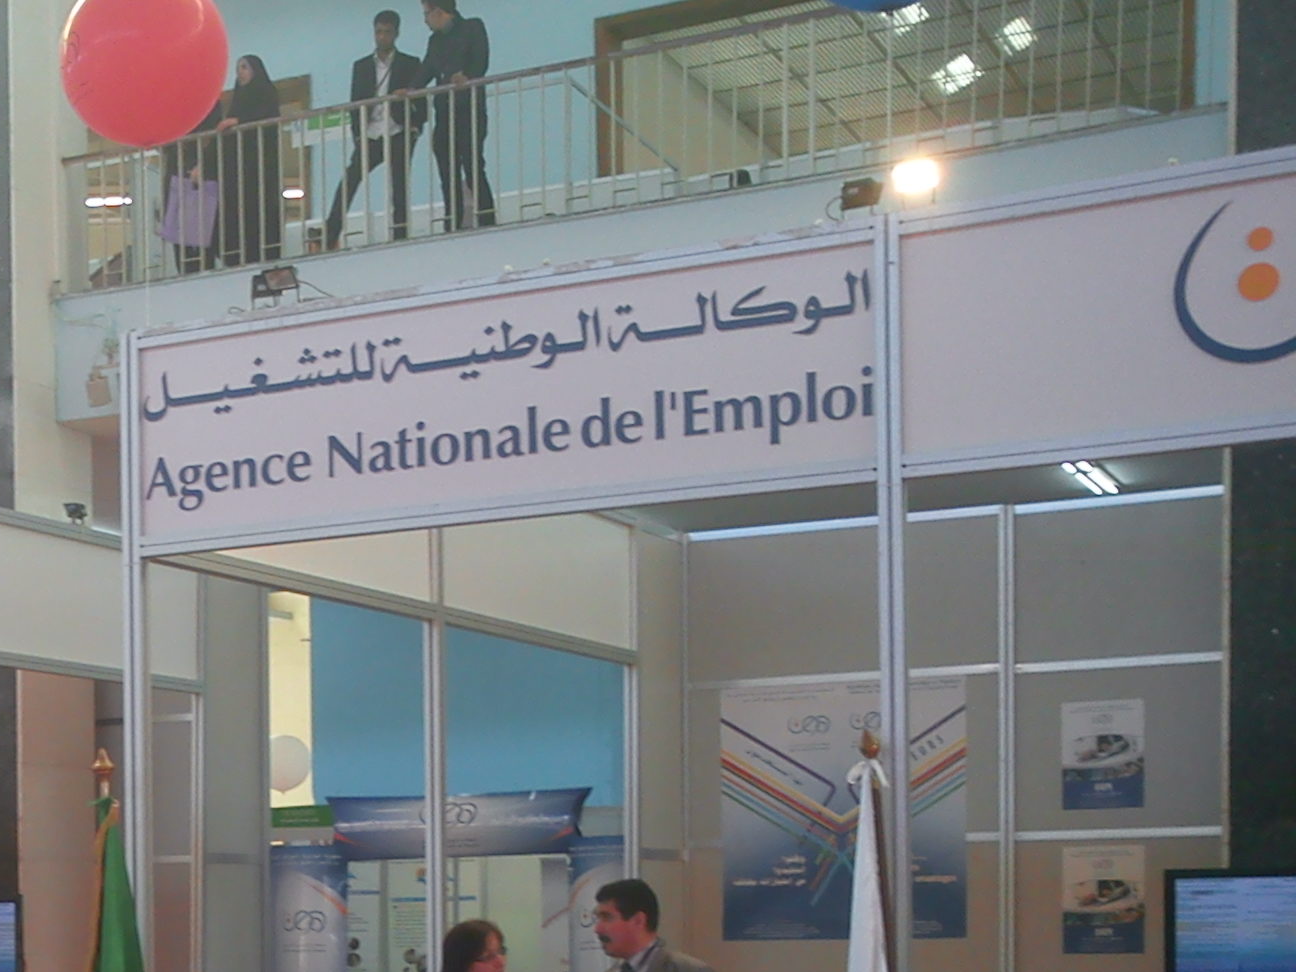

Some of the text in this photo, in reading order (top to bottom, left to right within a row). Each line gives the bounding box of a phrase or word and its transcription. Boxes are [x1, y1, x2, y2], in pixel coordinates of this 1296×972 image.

[145, 365, 875, 512] Agence Nationale de l'Emploi
